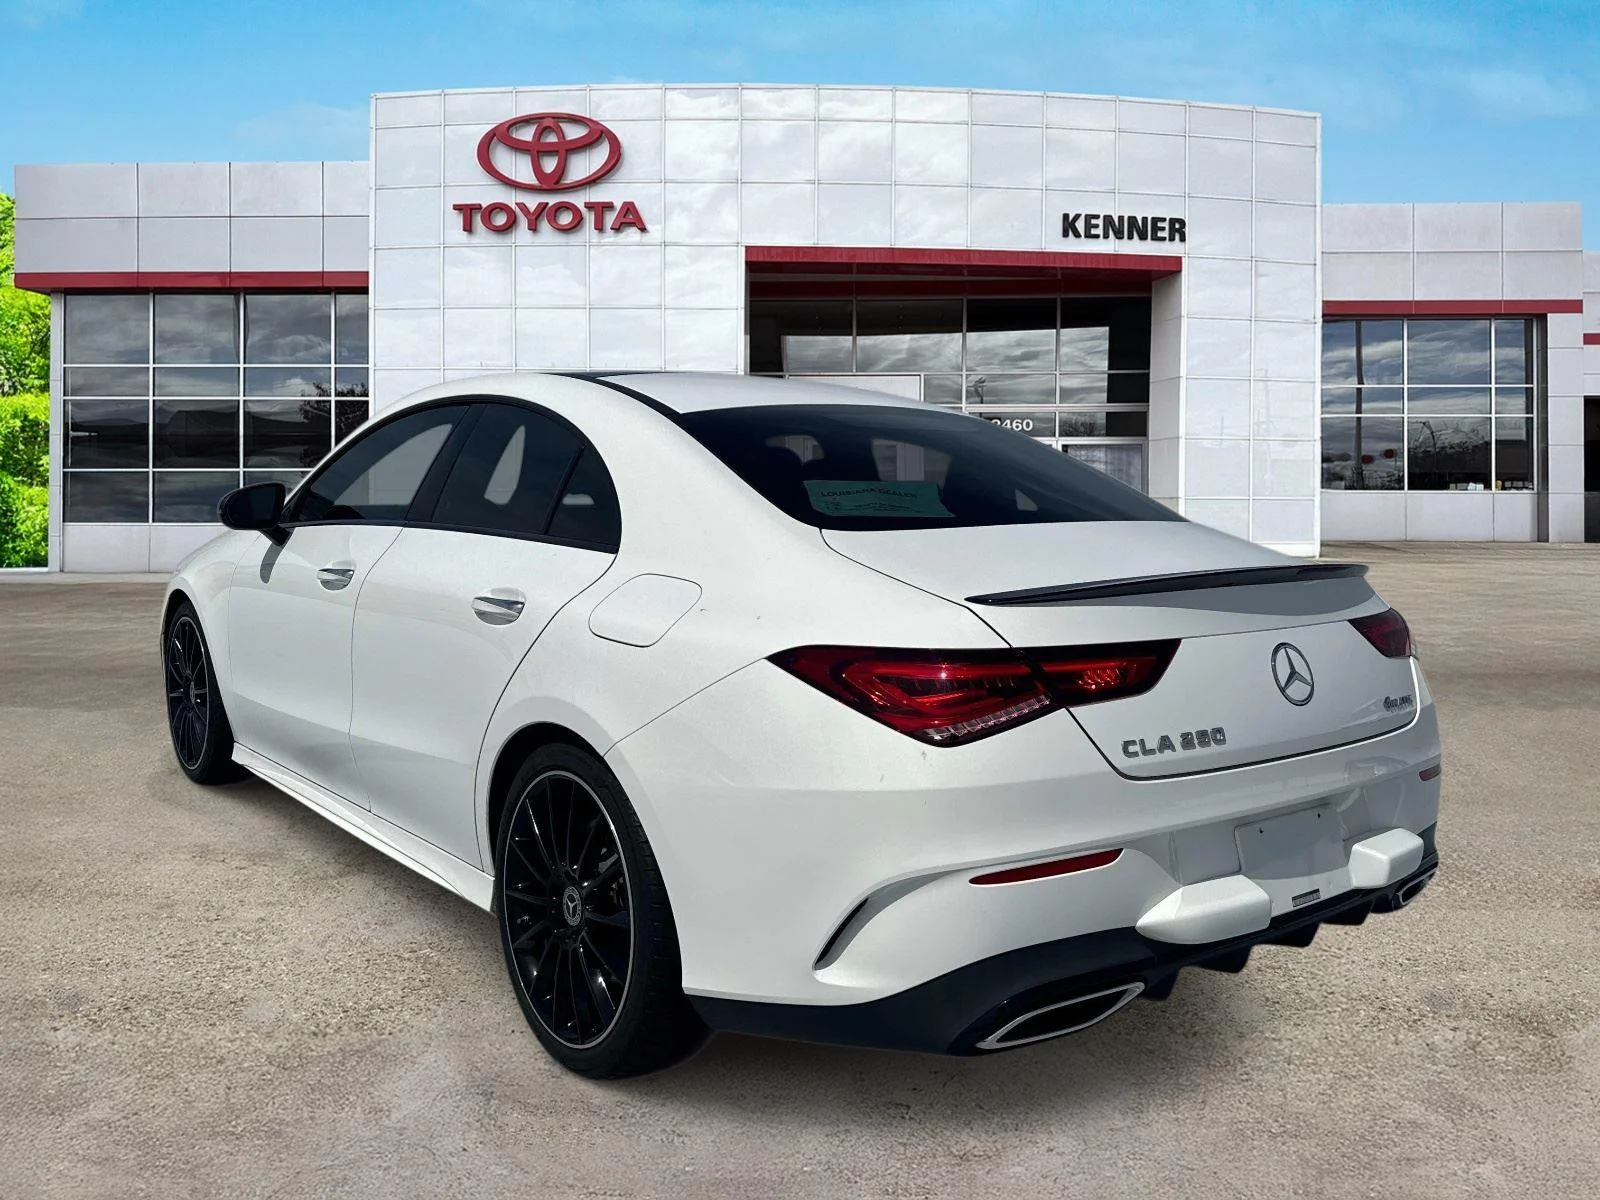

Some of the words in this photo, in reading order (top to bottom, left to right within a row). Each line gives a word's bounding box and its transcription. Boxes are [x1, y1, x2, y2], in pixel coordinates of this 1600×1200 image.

[452, 201, 648, 232] TOYOTA
[1062, 212, 1187, 243] KENNER
[1121, 734, 1177, 759] CLA
[1179, 726, 1227, 751] 250
